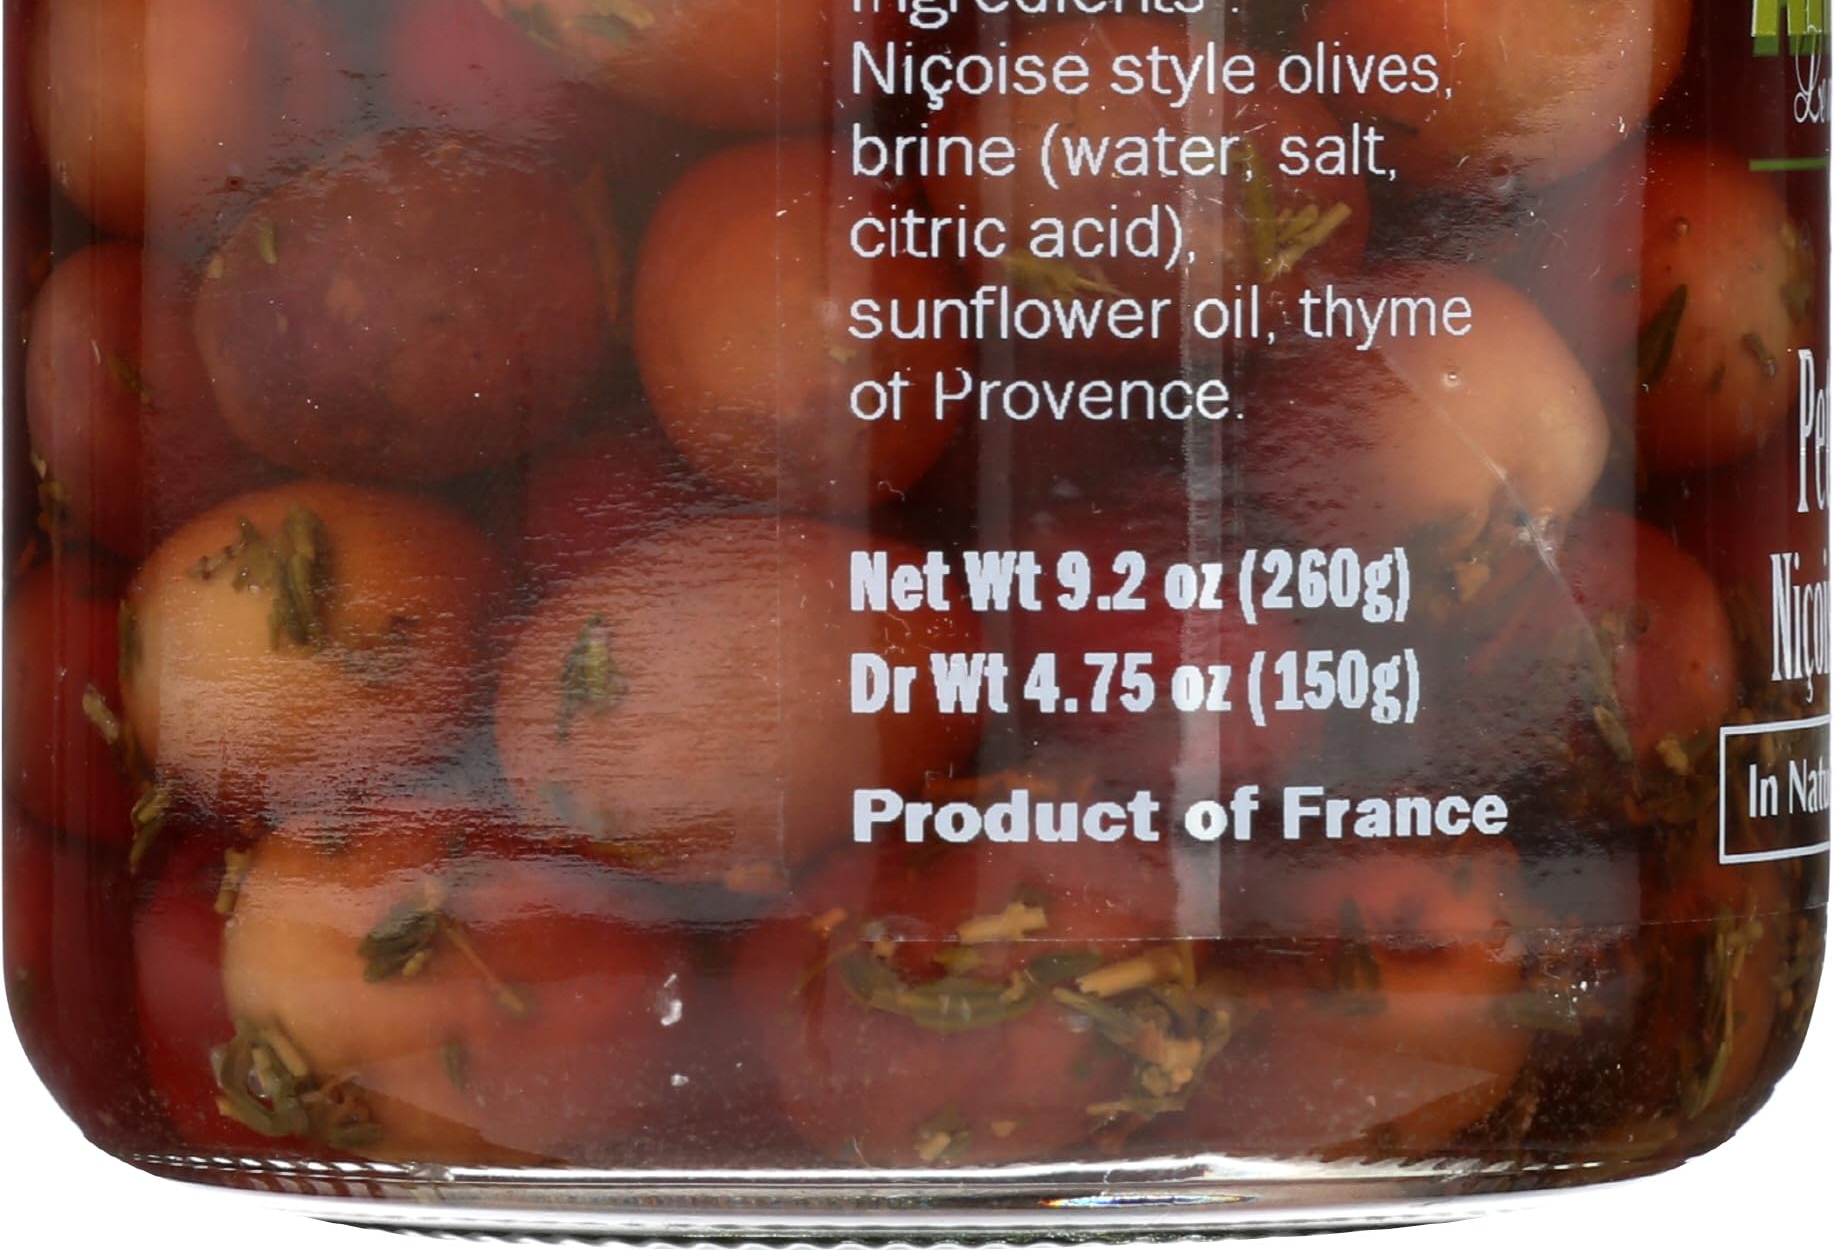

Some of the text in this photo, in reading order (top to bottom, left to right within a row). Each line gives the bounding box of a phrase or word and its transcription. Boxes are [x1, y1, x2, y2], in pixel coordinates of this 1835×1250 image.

[851, 40, 1454, 110] Niçoise style olives,
[851, 122, 1397, 190] brine (water, salt,
[849, 203, 1196, 271] citric acid),
[847, 283, 1473, 351] sunflower oil, thyme
[935, 366, 1244, 421] Provence.
[849, 547, 1410, 625] Net Wt 9.2 oz (260g)
[849, 648, 1421, 727] Dr Wt 4.75 oz (150g)
[852, 785, 1509, 844] Product of France
[1749, 763, 1779, 818] In
